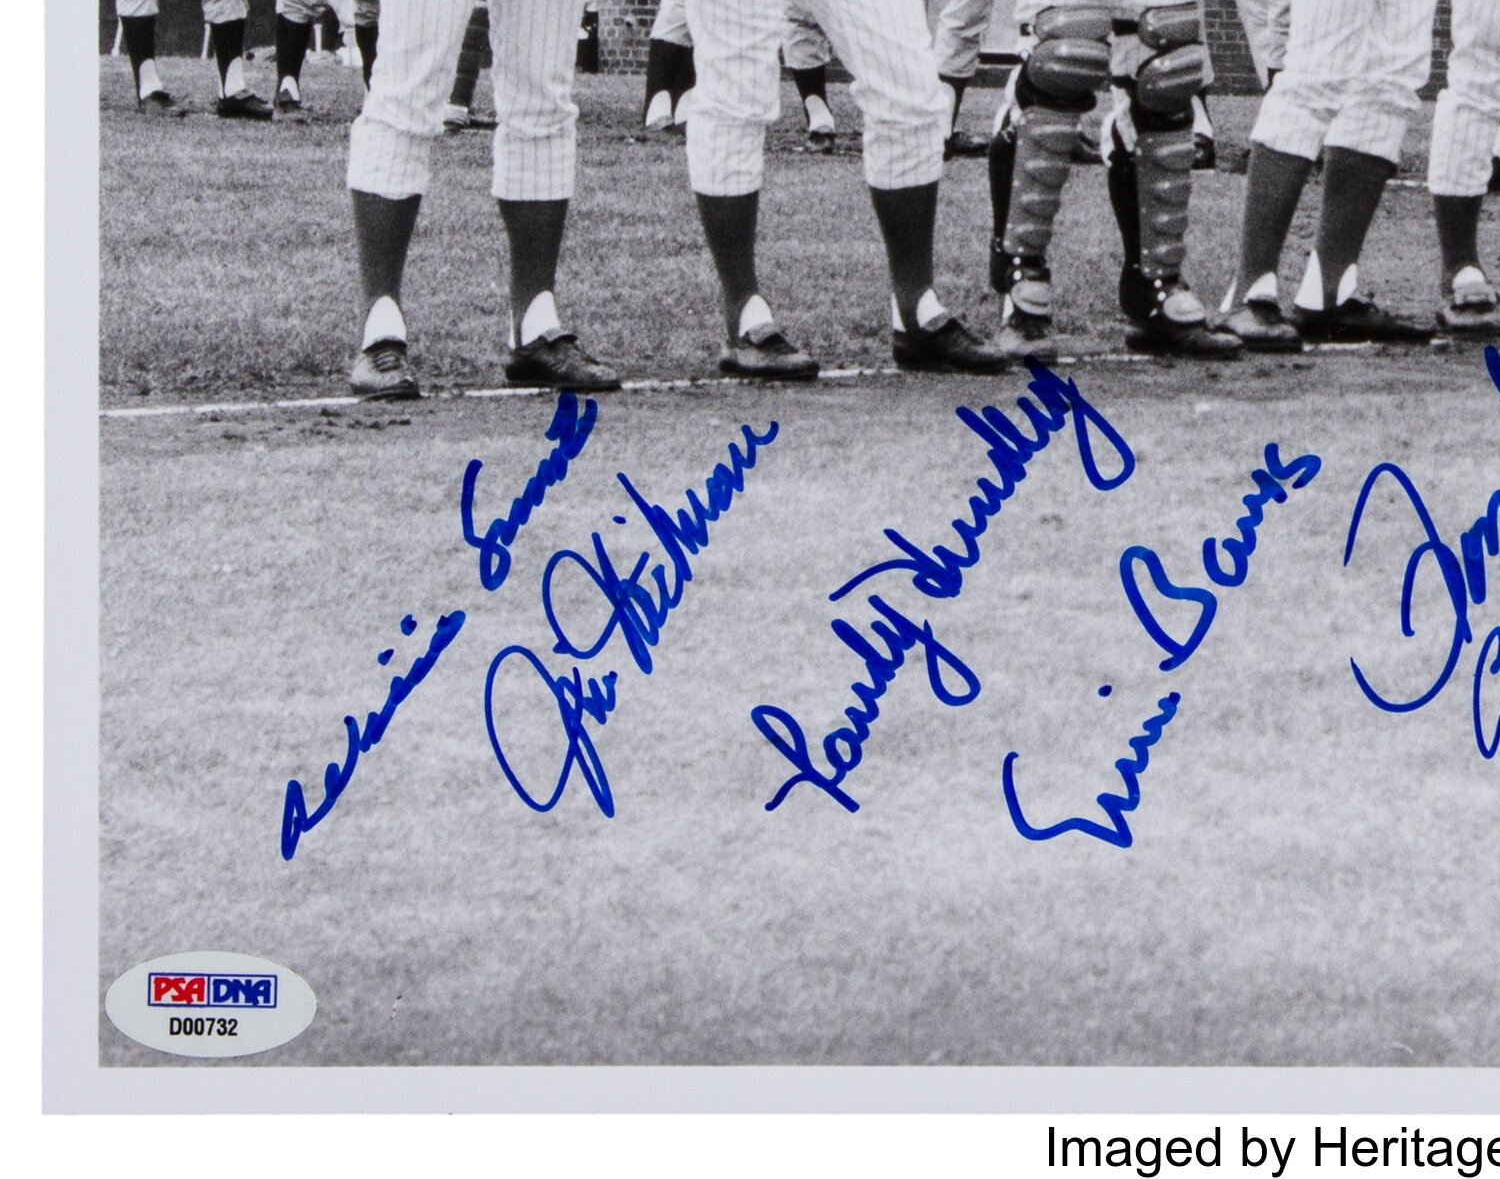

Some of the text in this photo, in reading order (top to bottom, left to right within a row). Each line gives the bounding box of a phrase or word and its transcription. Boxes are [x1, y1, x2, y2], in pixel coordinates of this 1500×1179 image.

[1119, 443, 1322, 672] Banks
[751, 595, 981, 813] Randy
[153, 976, 272, 1006] PSA DNA
[170, 1017, 238, 1036] D00732
